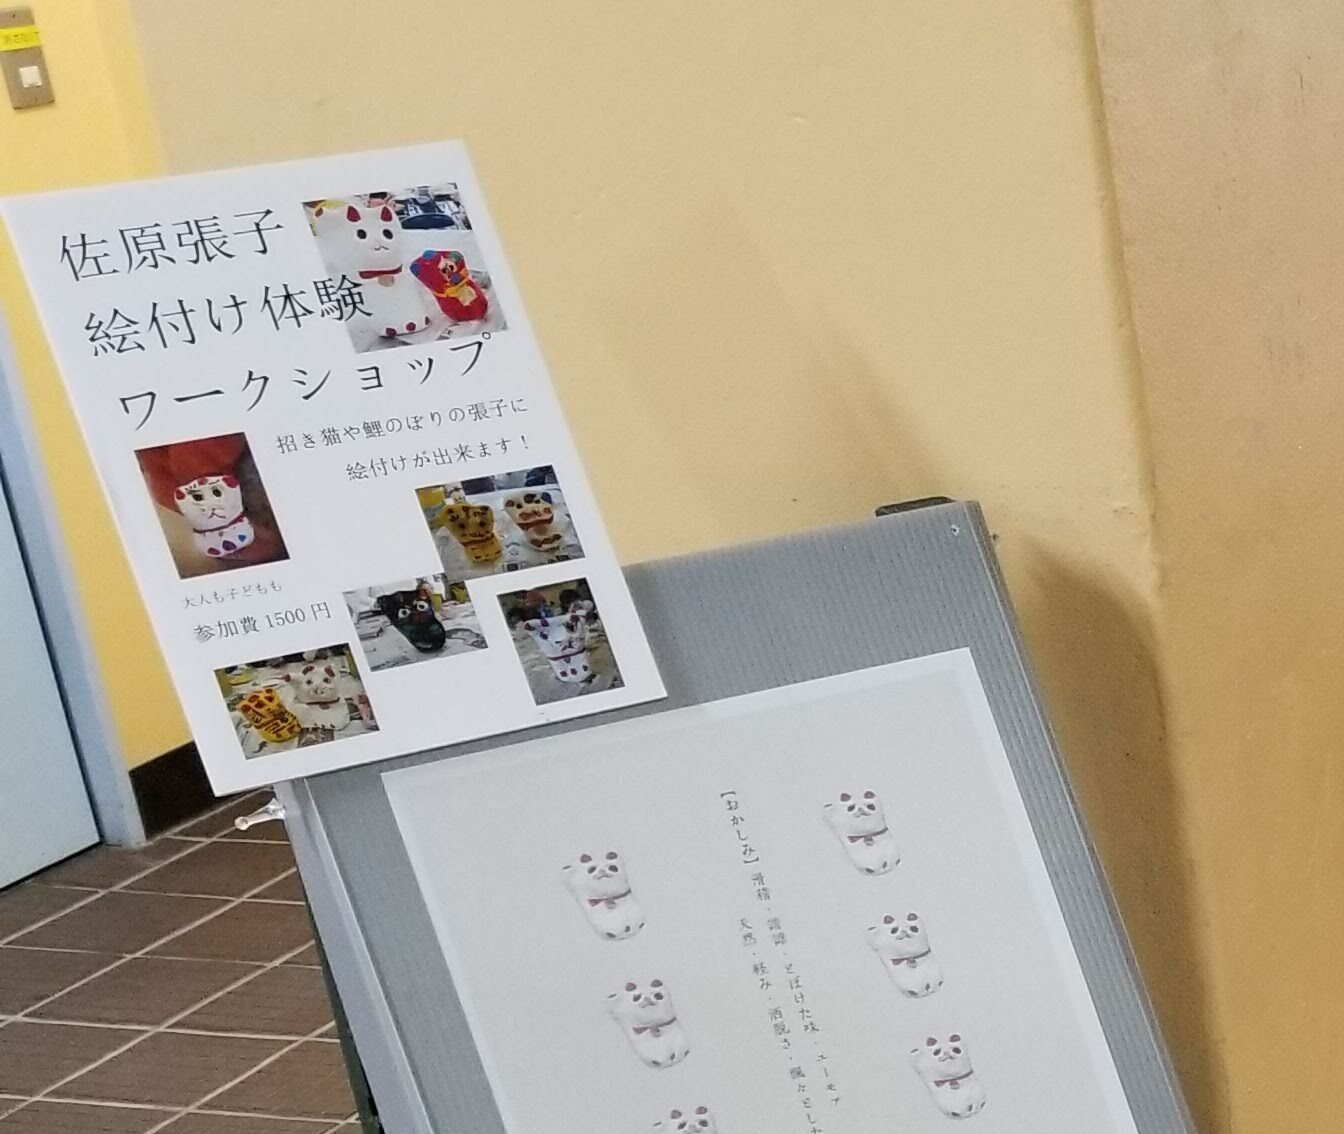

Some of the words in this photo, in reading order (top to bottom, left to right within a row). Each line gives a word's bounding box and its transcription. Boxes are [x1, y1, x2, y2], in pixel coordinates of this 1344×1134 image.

[59, 208, 284, 283] 佐原張子
[84, 273, 373, 357] 絵付け体験
[119, 331, 493, 431] ワークショップ
[276, 397, 529, 455] 招き猫や鯉のぼりの張子に
[182, 578, 283, 609] 大人も子どもも
